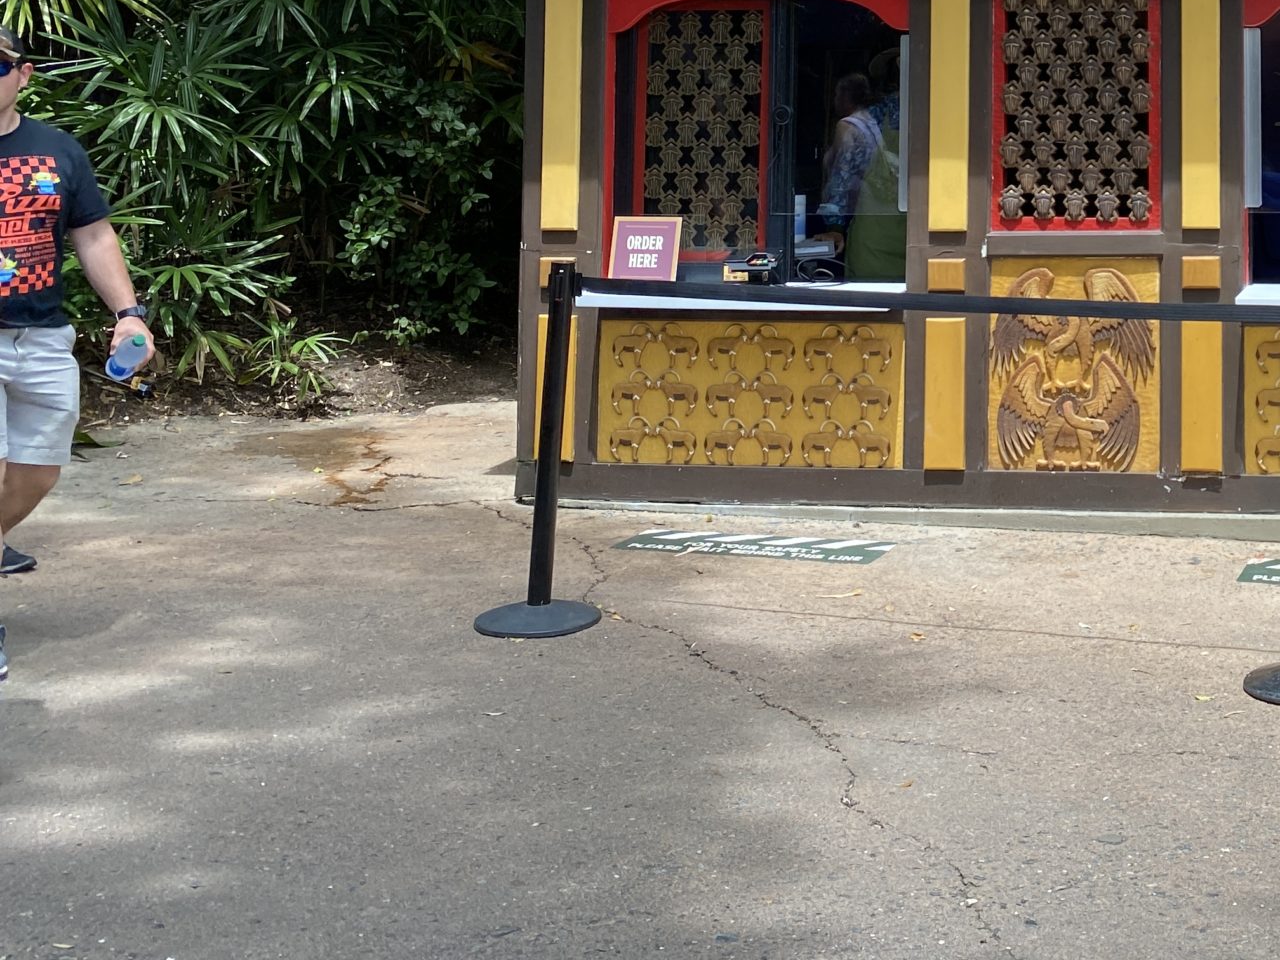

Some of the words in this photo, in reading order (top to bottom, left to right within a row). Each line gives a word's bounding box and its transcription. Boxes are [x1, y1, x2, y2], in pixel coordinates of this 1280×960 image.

[626, 235, 664, 251] ORDER
[628, 253, 659, 269] HERE
[626, 542, 683, 551] PLEASE
[729, 548, 785, 557] BEHIND
[828, 554, 864, 562] LINE
[720, 542, 760, 550] YOUR
[761, 545, 821, 554] SAFETY
